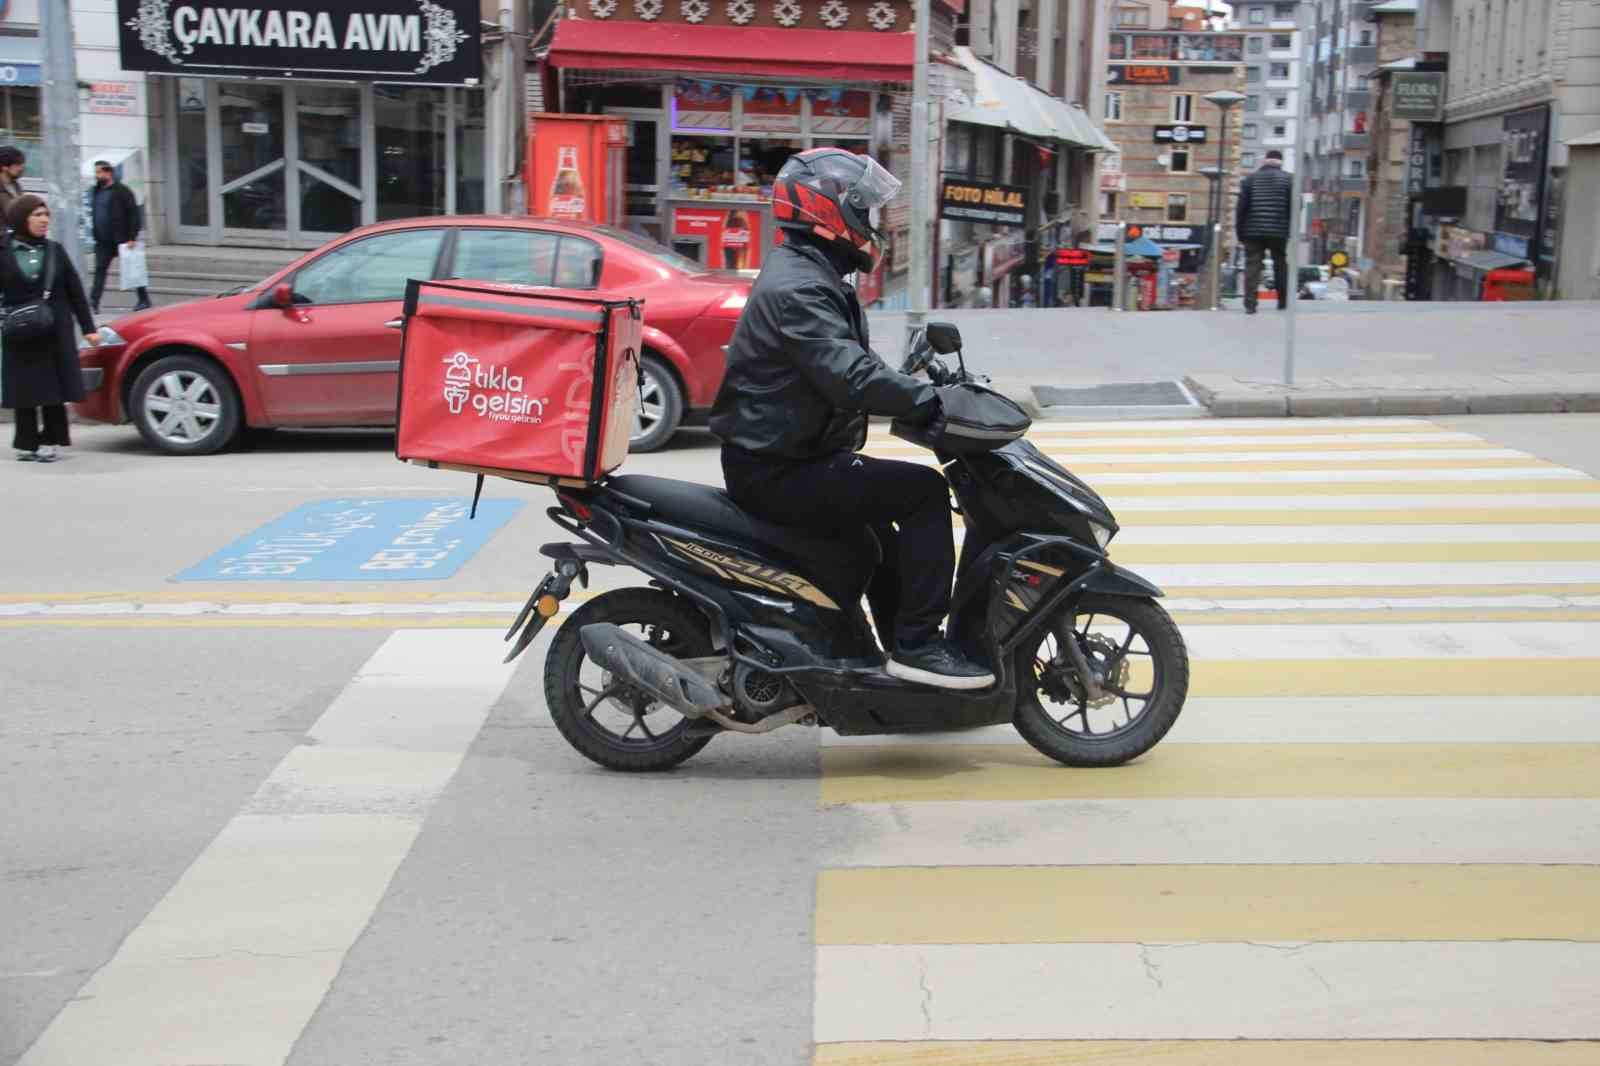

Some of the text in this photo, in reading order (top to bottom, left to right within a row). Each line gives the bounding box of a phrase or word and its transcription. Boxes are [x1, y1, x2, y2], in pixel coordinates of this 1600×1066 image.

[173, 5, 420, 54] ÇAYKARA AVM
[1397, 83, 1438, 96] FLORA
[944, 185, 1025, 208] FOTO HİLAL
[472, 392, 543, 416] gelsin
